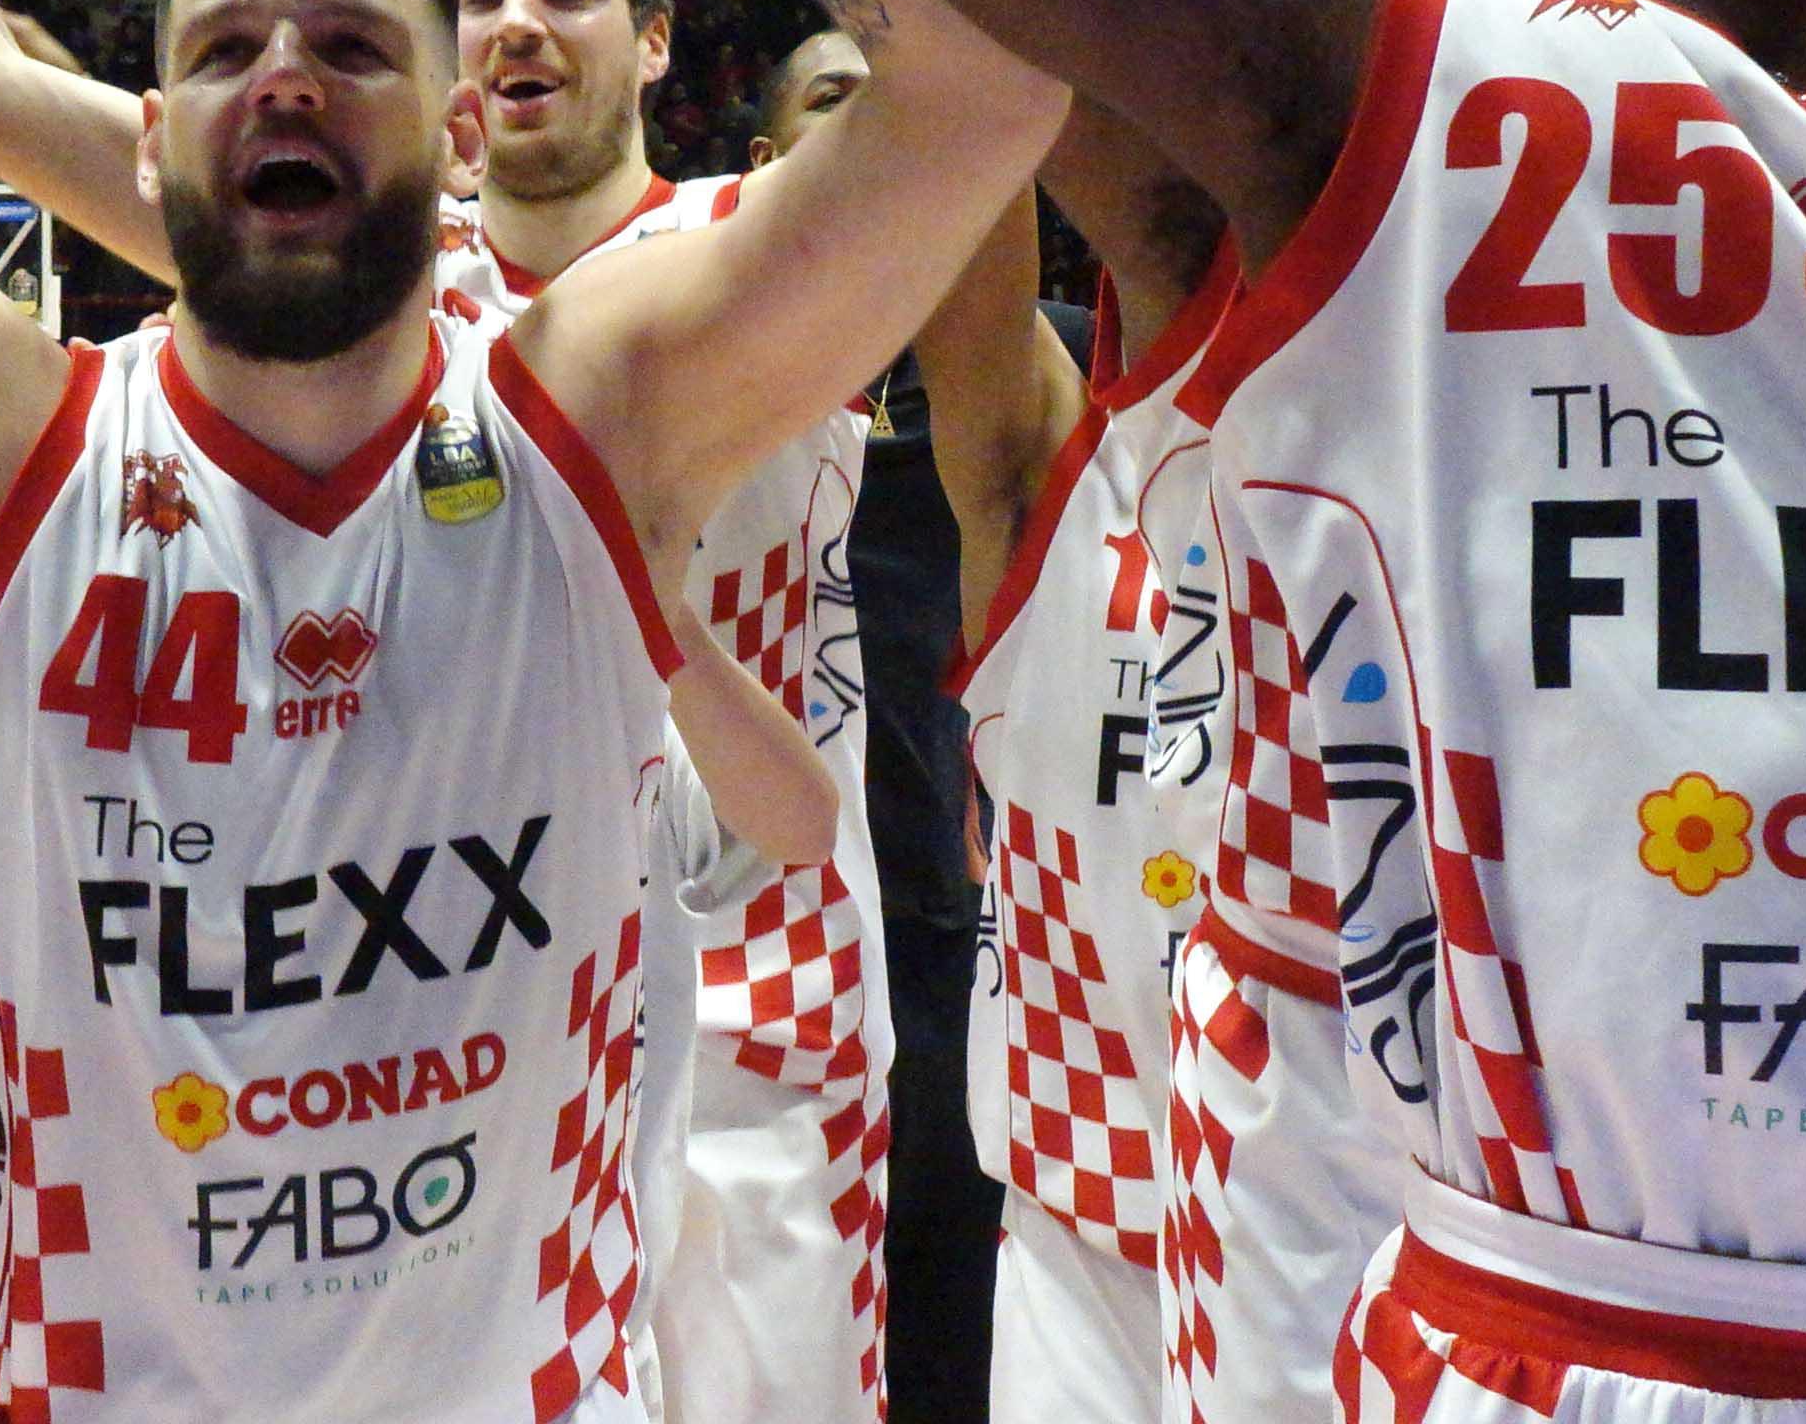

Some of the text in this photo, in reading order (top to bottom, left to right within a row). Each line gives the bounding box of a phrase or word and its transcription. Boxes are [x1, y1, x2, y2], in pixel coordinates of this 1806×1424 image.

[1444, 76, 1776, 337] 25
[1530, 383, 1725, 471] The
[39, 573, 248, 766] 44
[82, 793, 216, 866] The
[77, 812, 555, 1020] FLEXX
[234, 1031, 507, 1138] CONAD
[187, 1130, 478, 1272] FABO
